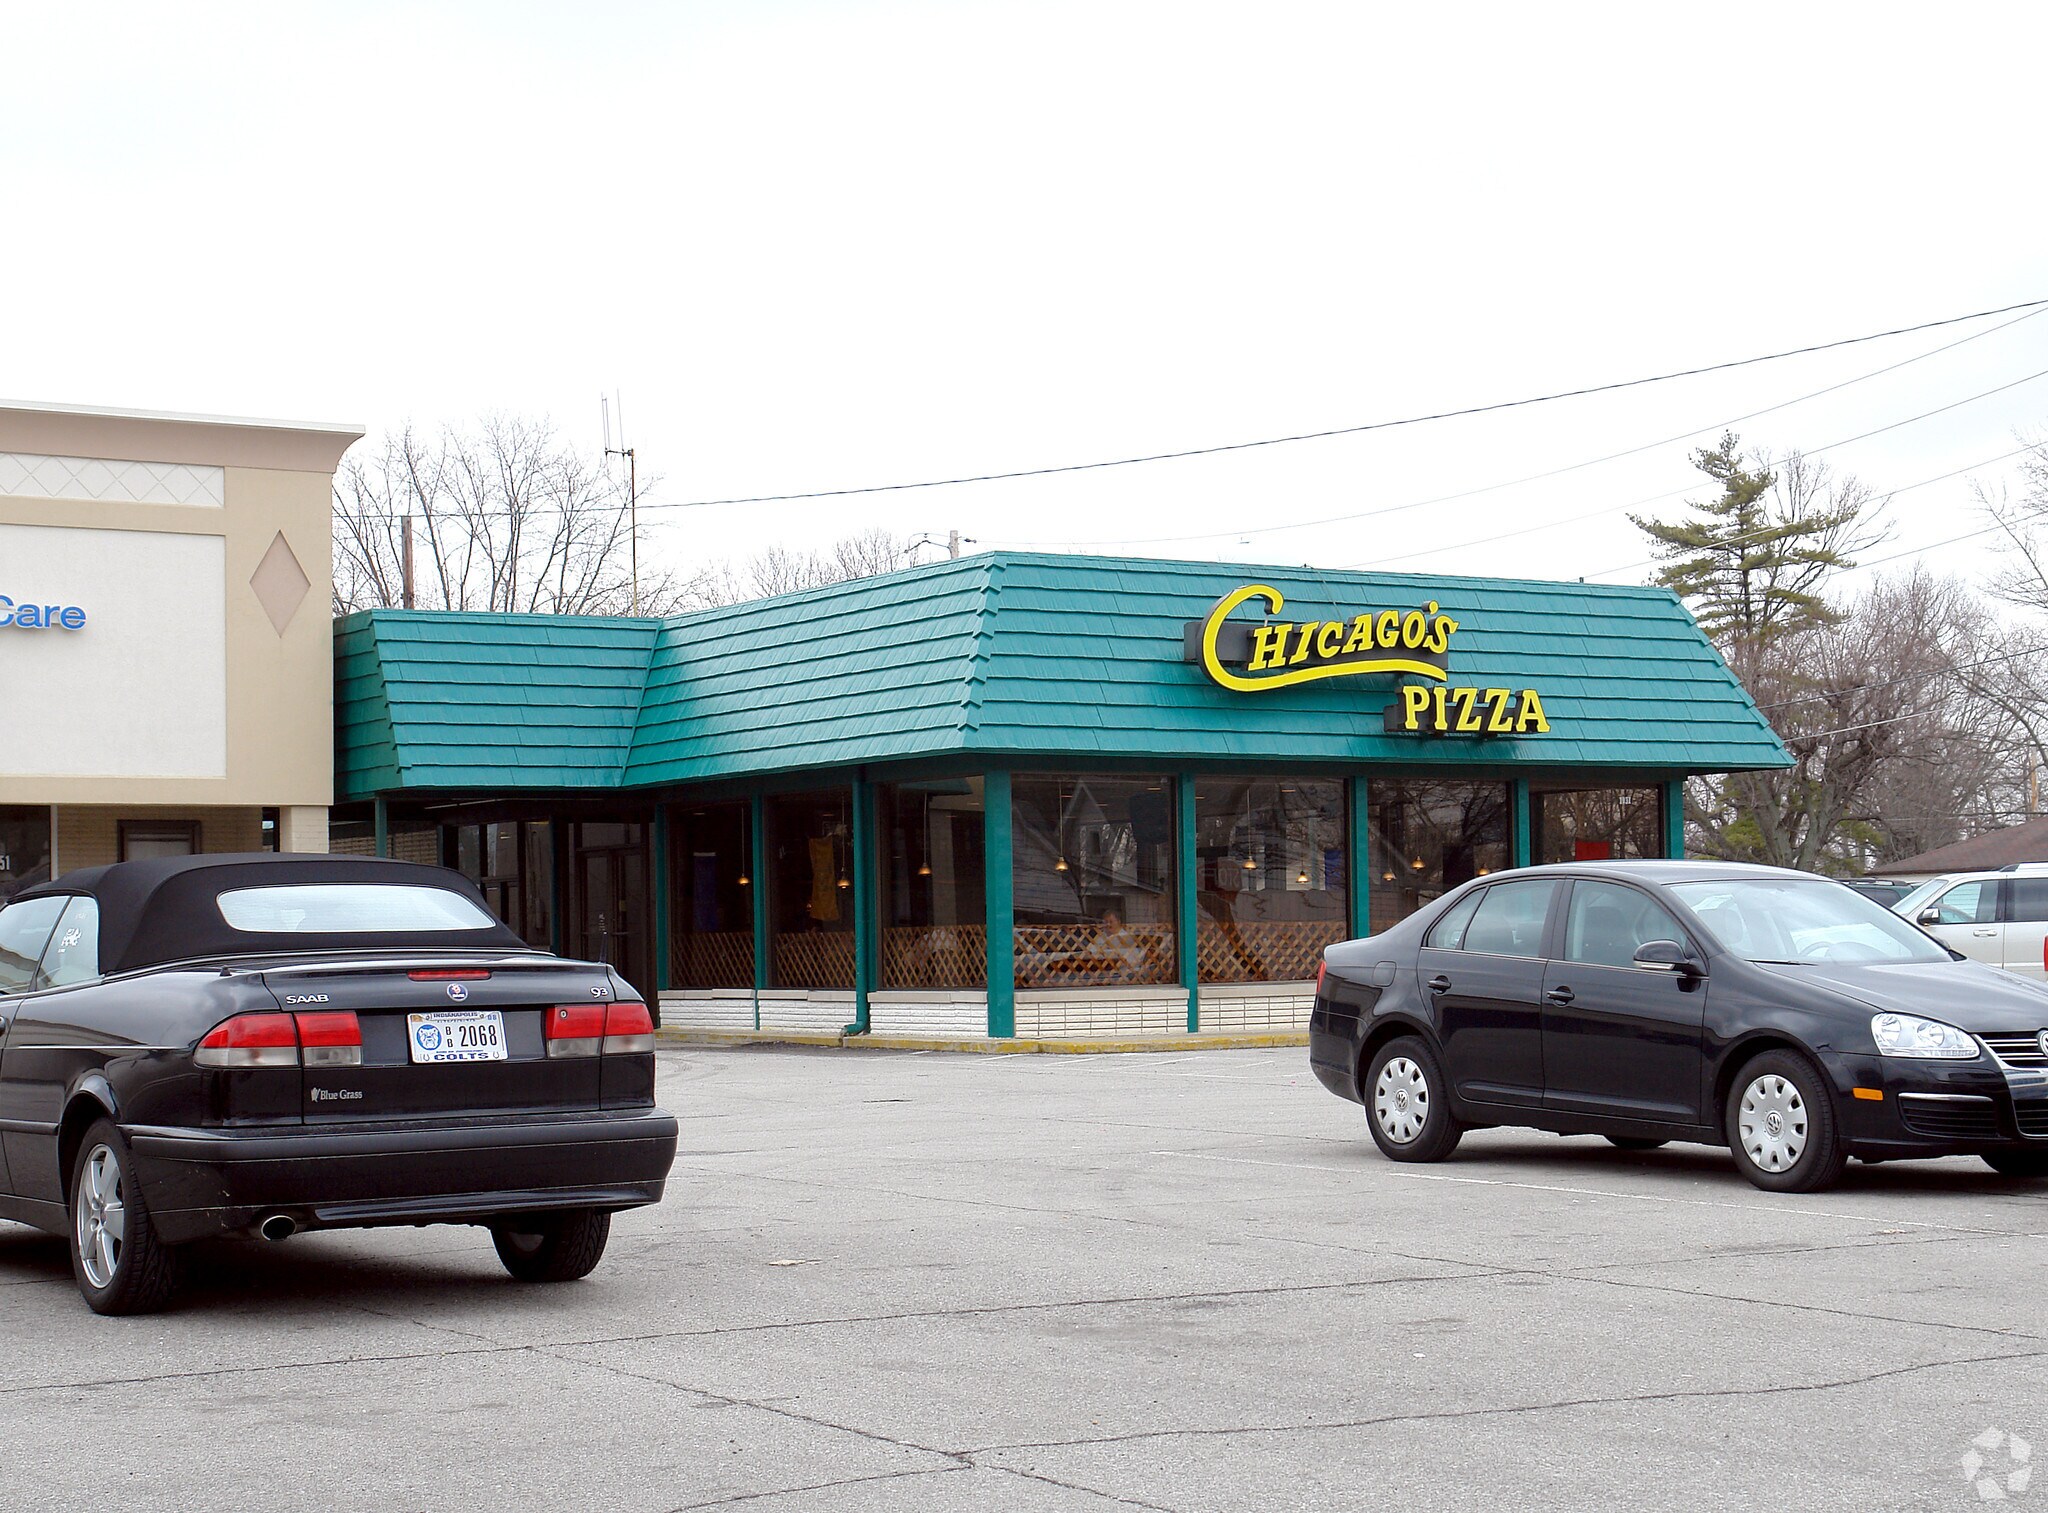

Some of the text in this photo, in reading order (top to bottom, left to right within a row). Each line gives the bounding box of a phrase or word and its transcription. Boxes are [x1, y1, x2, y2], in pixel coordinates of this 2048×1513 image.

[1202, 584, 1459, 692] CHICAGO'S
[1401, 685, 1551, 733] PIZZA
[285, 994, 330, 1004] SAAB
[459, 1024, 498, 1047] 2068
[433, 1052, 489, 1060] COLTS
[320, 1089, 363, 1100] Blue Grass
